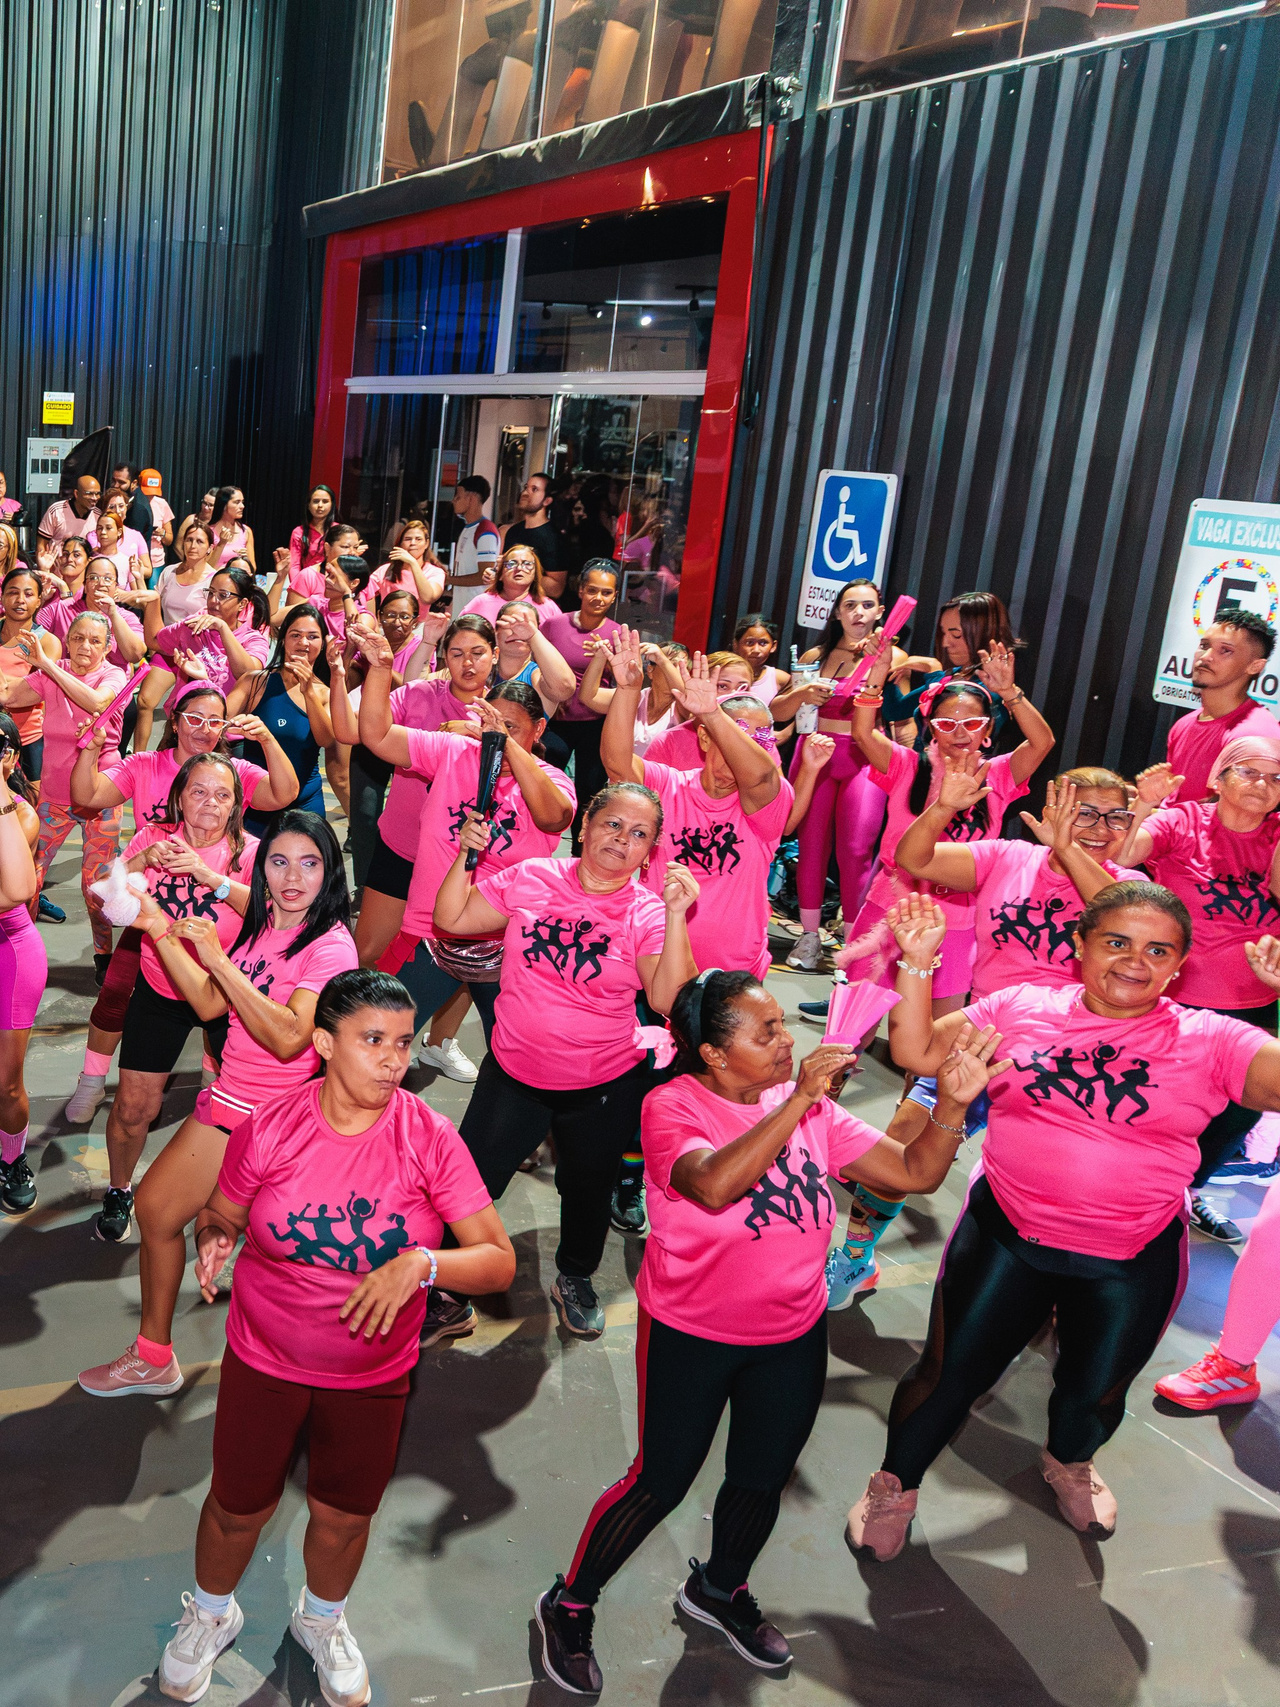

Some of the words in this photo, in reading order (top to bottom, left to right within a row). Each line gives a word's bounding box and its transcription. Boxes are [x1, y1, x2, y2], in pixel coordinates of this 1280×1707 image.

[1196, 516, 1231, 545] VAGA
[808, 585, 840, 602] ESTACIO
[804, 604, 830, 621] EXCL
[1161, 685, 1203, 703] OBRIGATOR
[844, 1266, 866, 1285] FILA
